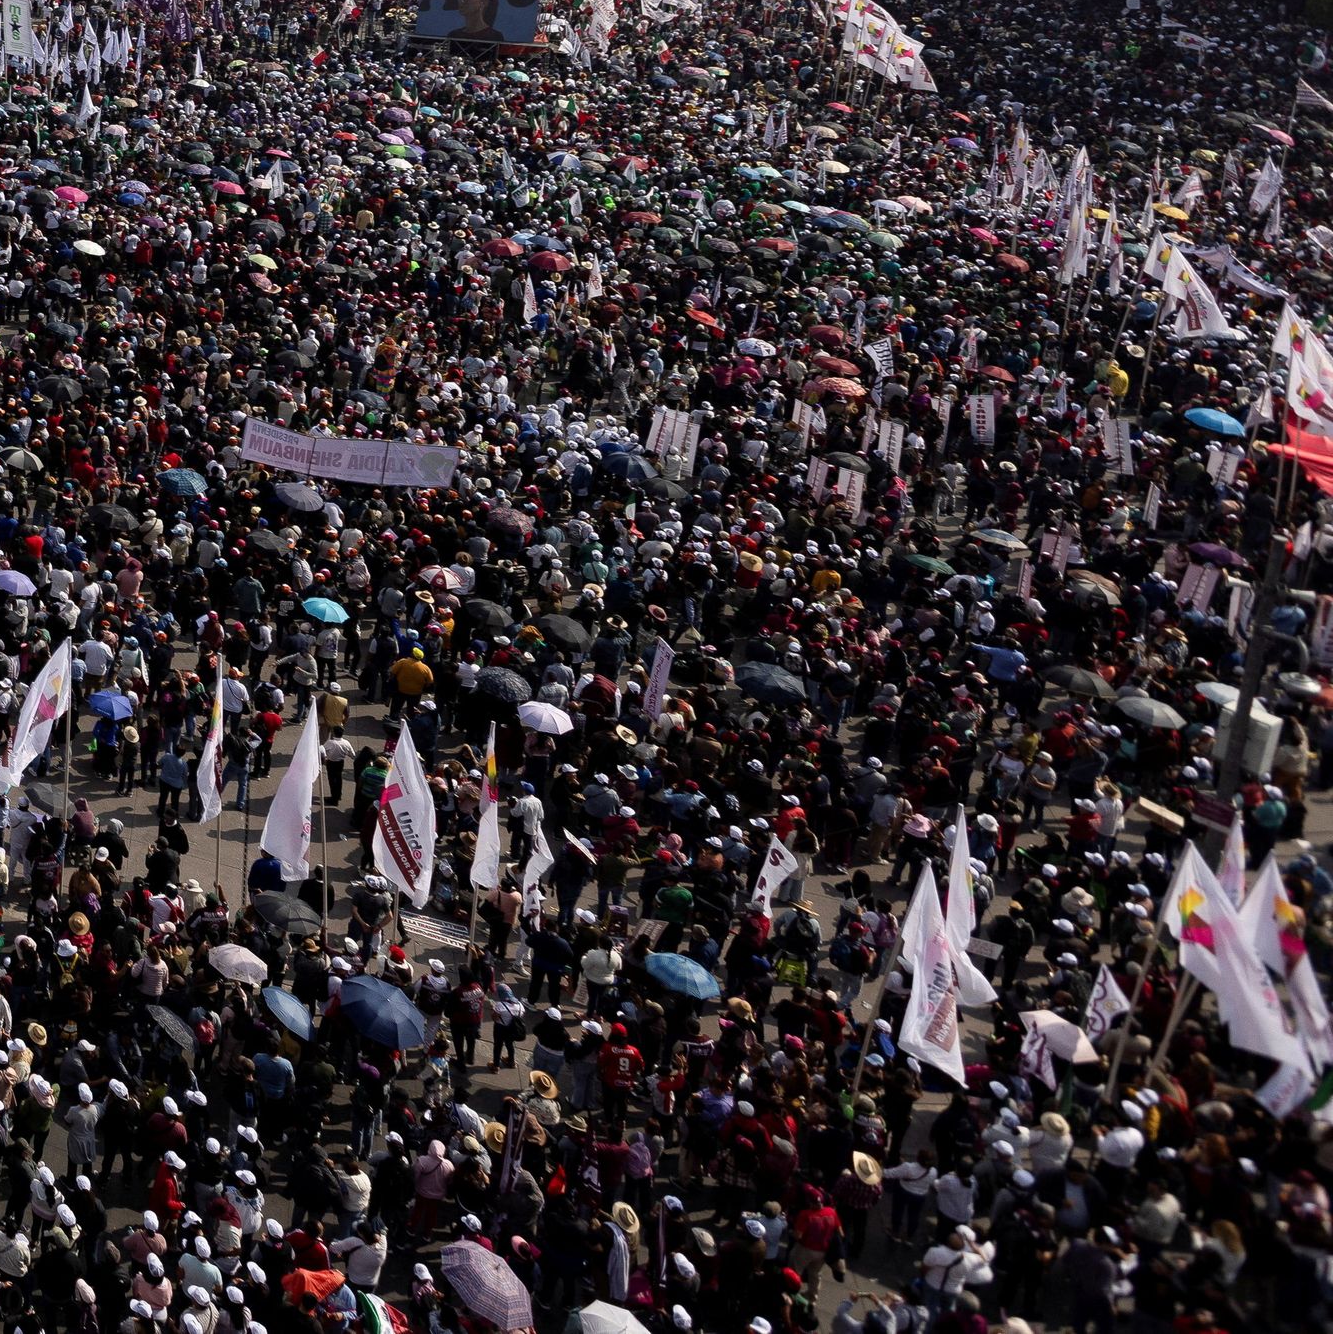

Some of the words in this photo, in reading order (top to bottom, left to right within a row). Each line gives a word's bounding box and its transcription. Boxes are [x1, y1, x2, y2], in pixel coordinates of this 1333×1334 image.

[377, 808, 392, 827] POR
[385, 825, 397, 839] UN
[390, 838, 411, 869] MEJOR
[611, 1046, 635, 1055] Corona
[619, 1057, 630, 1072] 9
